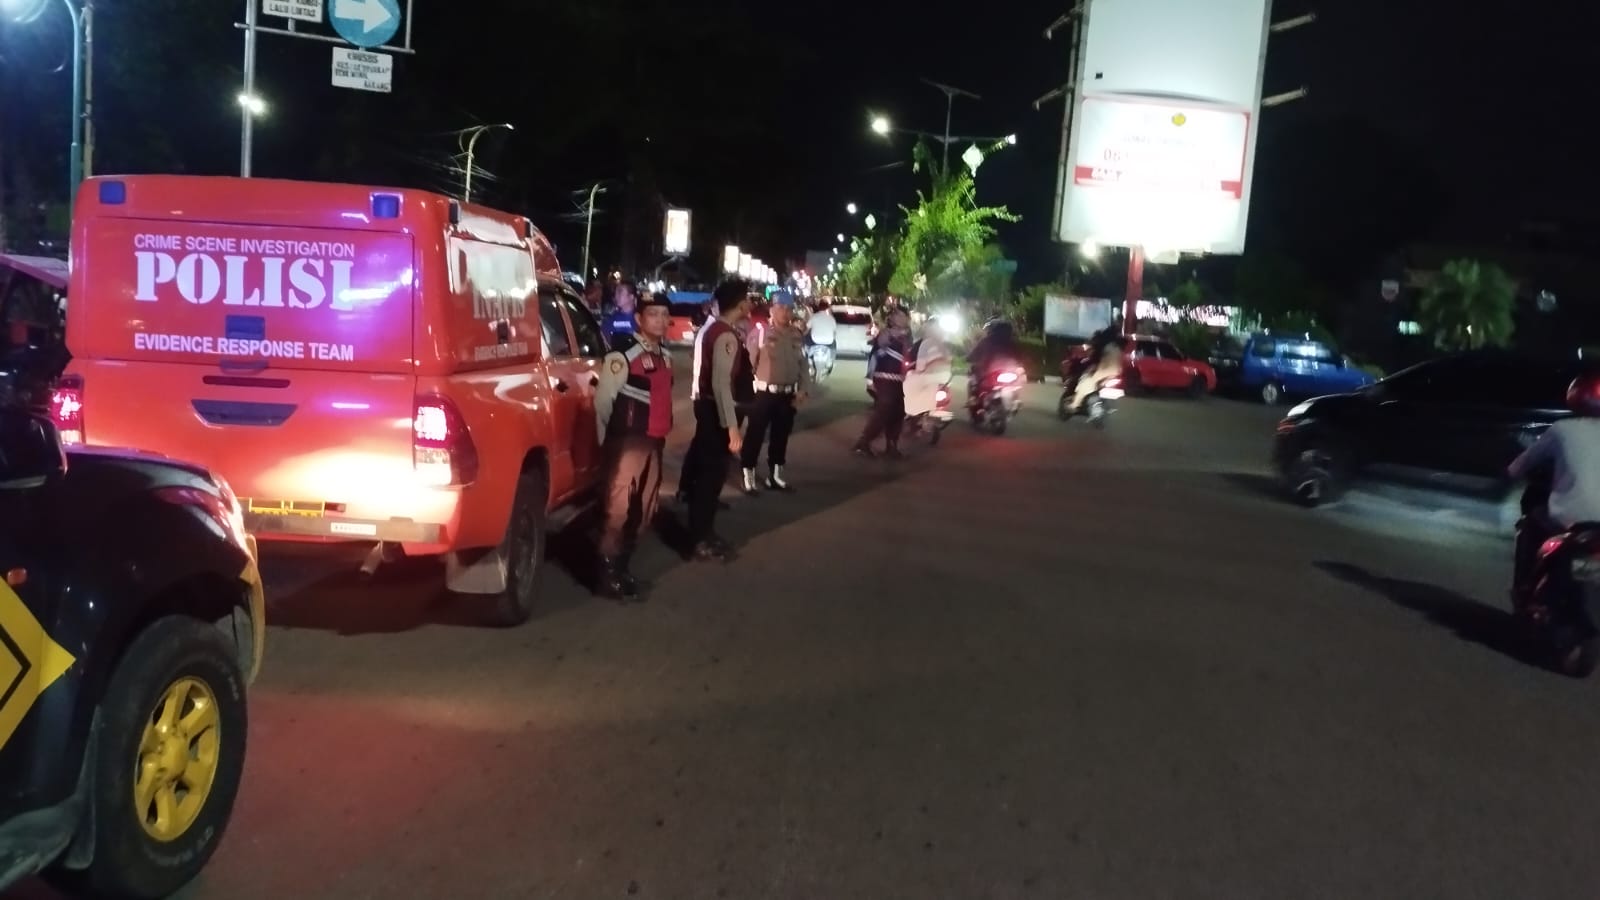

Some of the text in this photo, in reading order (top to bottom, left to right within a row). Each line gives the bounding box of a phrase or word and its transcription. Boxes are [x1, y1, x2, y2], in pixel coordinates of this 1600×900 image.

[134, 233, 355, 258] CRIME SCENE INVESTIGATION
[134, 251, 354, 311] POLISI
[134, 333, 354, 361] EVIDENCE RESPONSE TEAM
